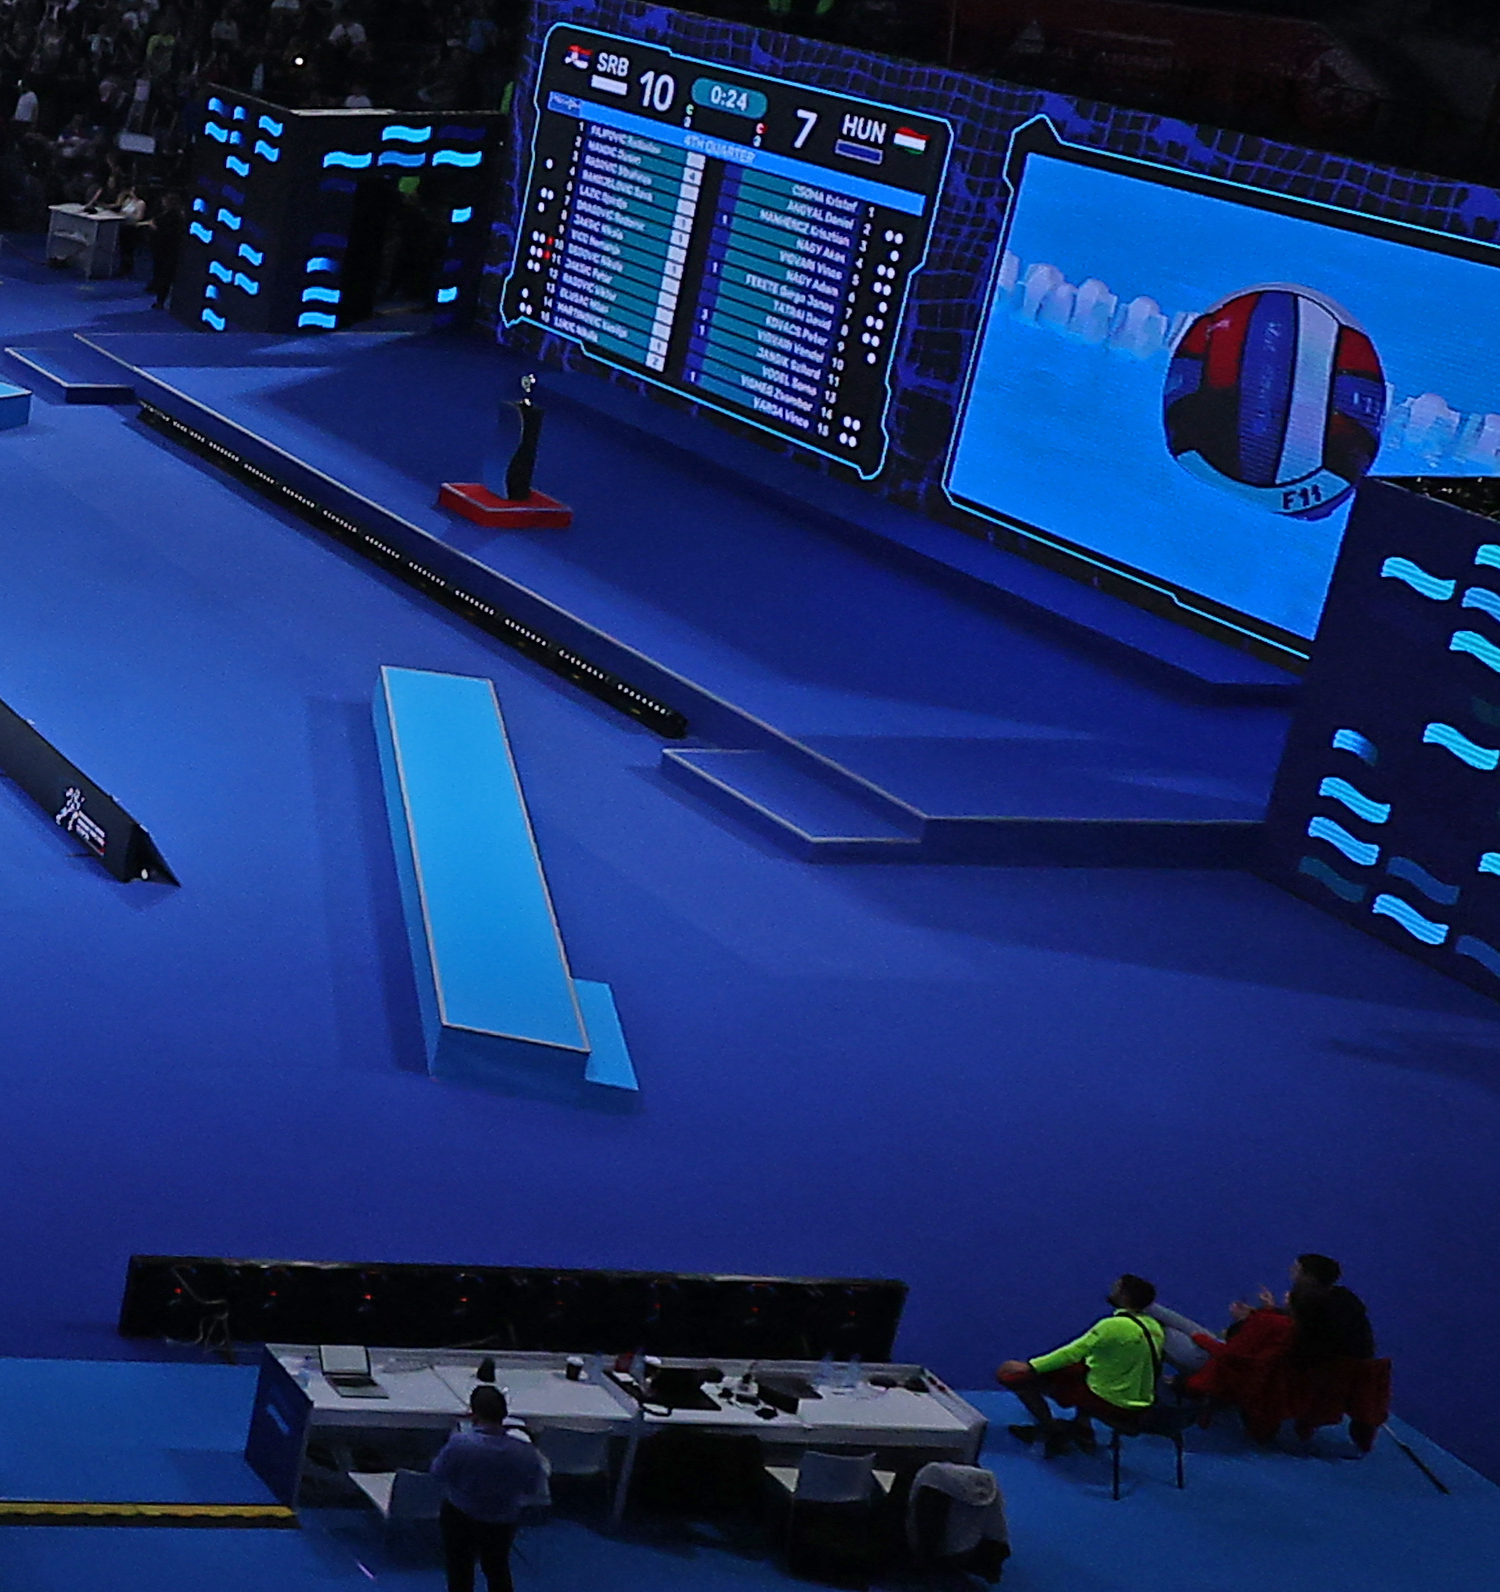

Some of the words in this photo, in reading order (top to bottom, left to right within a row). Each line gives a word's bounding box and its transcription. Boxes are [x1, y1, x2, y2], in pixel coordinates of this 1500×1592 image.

[597, 52, 629, 77] SRB
[640, 70, 675, 112] 10
[711, 85, 748, 111] 0:24
[794, 109, 818, 148] 7
[842, 113, 887, 144] HUN
[1282, 484, 1323, 510] F11
